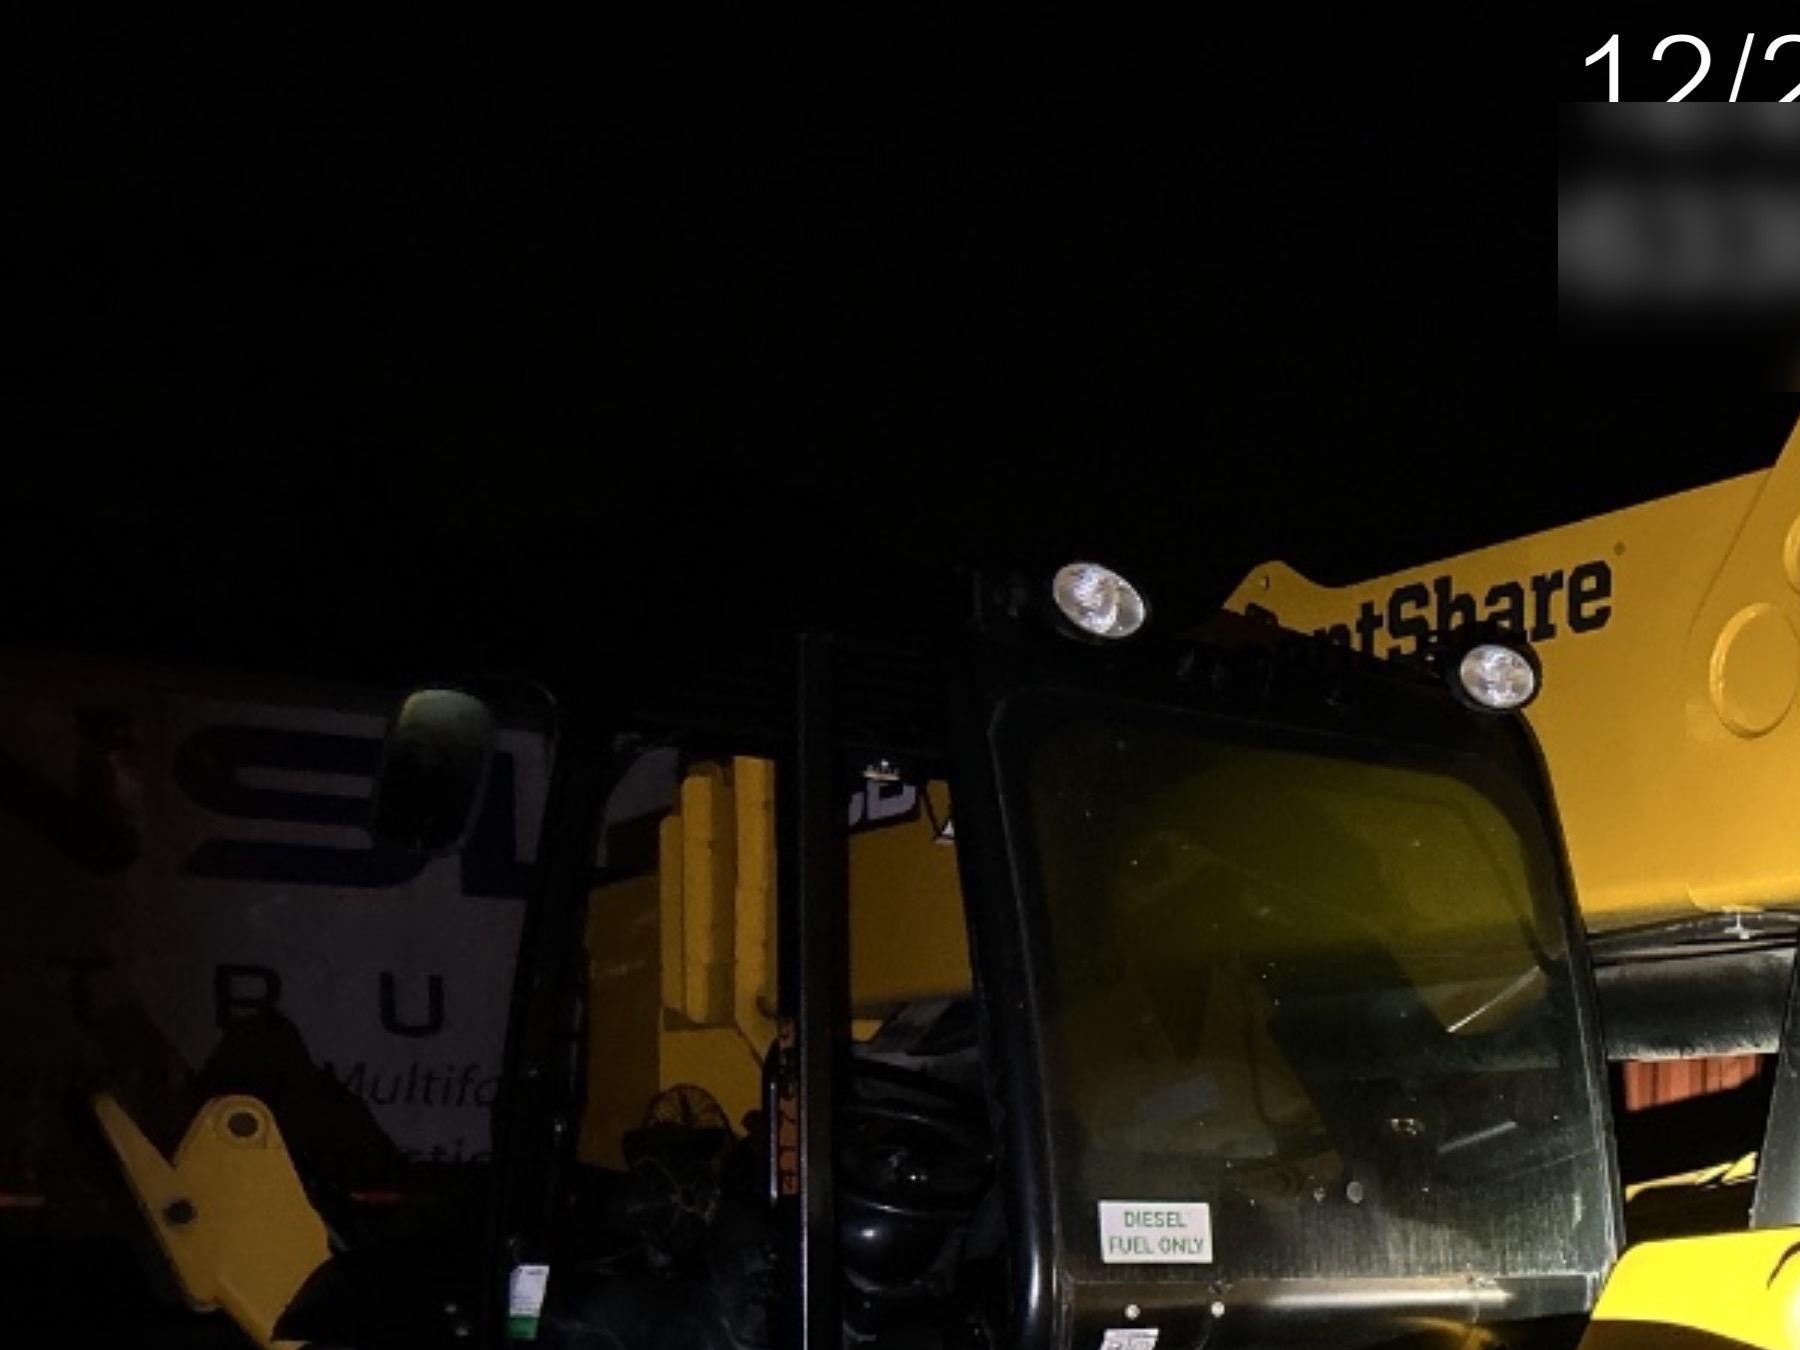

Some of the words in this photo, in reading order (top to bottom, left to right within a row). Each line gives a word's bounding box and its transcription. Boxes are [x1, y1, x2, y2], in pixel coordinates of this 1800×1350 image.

[1123, 1210, 1188, 1229] DIESEL
[1107, 1235, 1154, 1255] FUEL
[1157, 1236, 1204, 1256] ONLY
